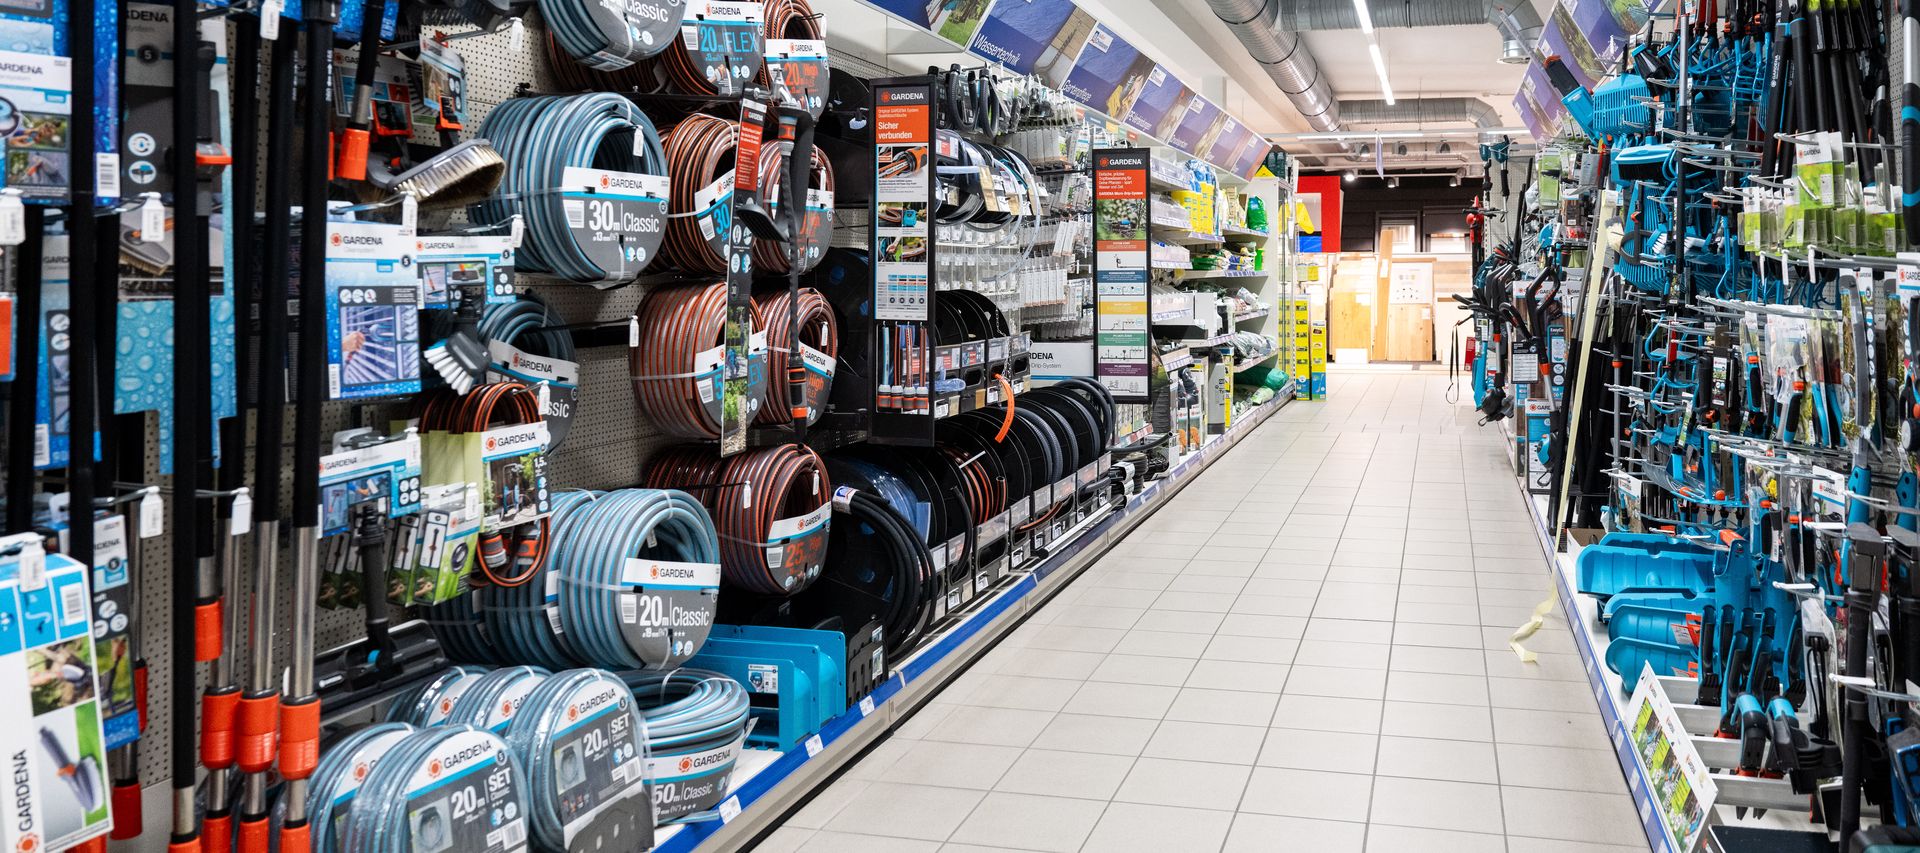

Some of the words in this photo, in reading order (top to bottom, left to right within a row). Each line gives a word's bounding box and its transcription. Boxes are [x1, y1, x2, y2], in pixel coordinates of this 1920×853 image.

[711, 6, 741, 15] GARDENA
[725, 31, 759, 53] FLEX
[795, 44, 813, 52] GARDENA
[974, 33, 1020, 67] Wassertechnik
[0, 62, 44, 75] ARDENA
[1062, 79, 1092, 103] Gartenpflege
[878, 121, 899, 130] Sicher
[878, 131, 912, 139] verbunden
[1109, 158, 1142, 166] GARDENA
[611, 178, 643, 189] GARDENA
[589, 200, 620, 231] 30m
[623, 212, 660, 233] Classic
[343, 235, 383, 246] GARDENA
[424, 242, 455, 250] GARDENA
[43, 256, 70, 264] GARD
[1905, 271, 1920, 280] GARDE
[519, 358, 552, 374] GARDENA
[805, 350, 826, 366] GARDENA
[547, 399, 570, 418] ssic
[497, 431, 536, 447] GARDENA
[325, 457, 357, 470] GARDENA
[660, 568, 694, 579] GARDENA
[639, 595, 669, 627] 20m
[672, 606, 710, 627] Classic
[580, 688, 617, 714] GARDENA
[611, 712, 630, 734] SET
[443, 740, 492, 769] GARDENA
[693, 749, 731, 768] GARDENA
[488, 767, 511, 792] SET
[13, 749, 34, 832] GARDENA
[683, 782, 713, 801] Classic
